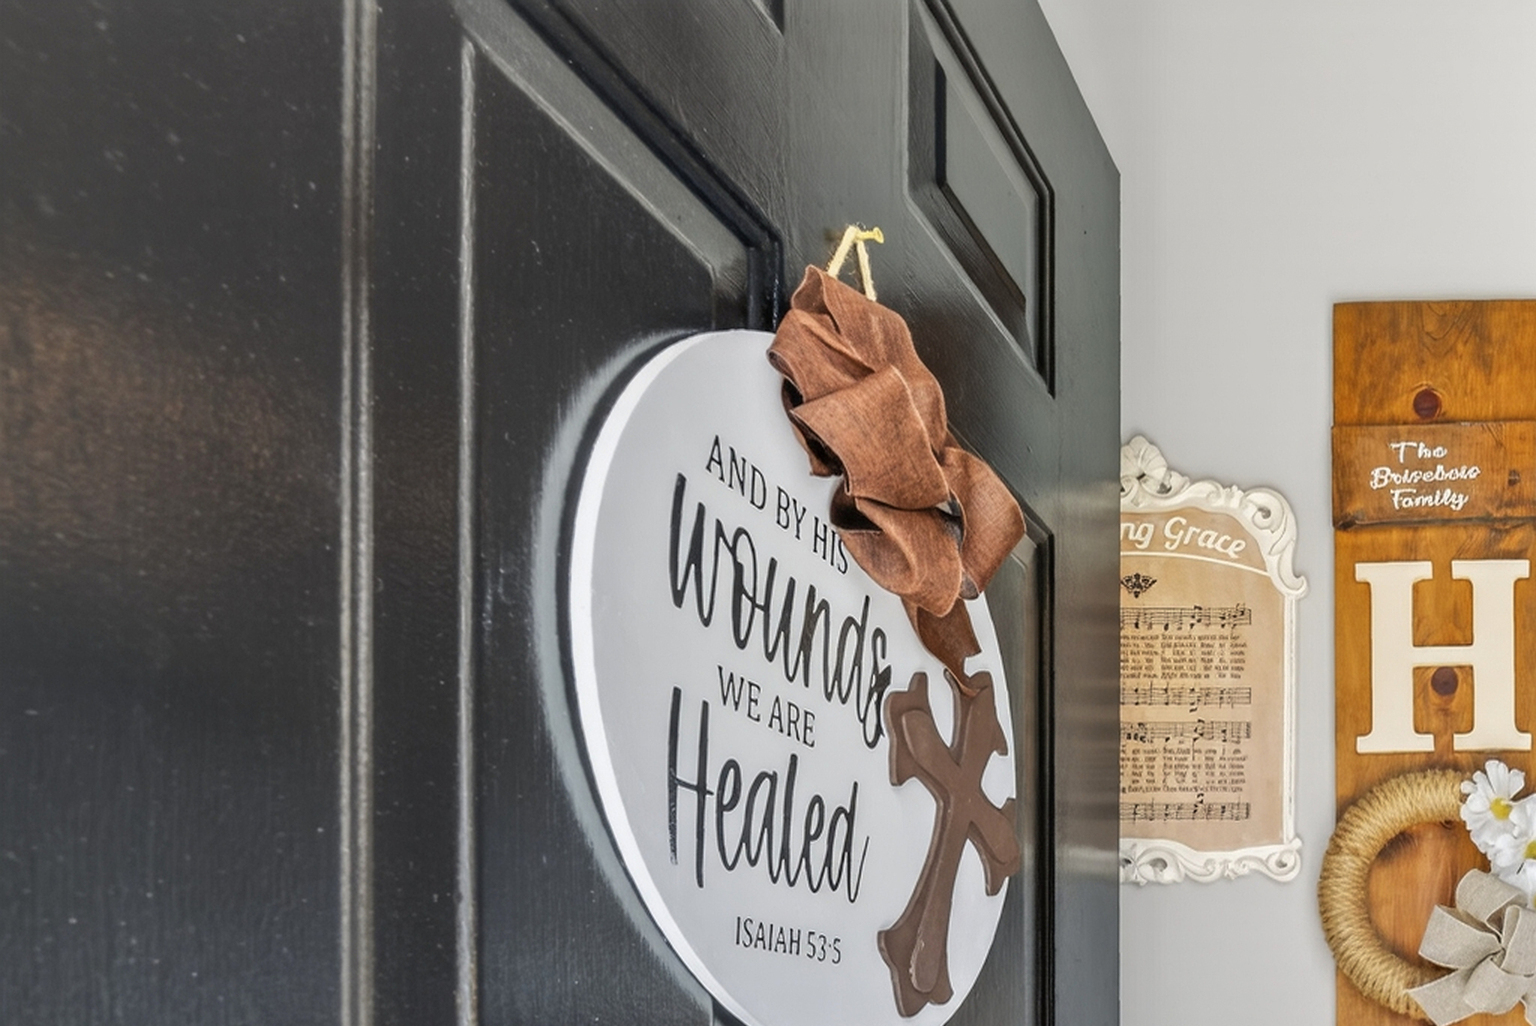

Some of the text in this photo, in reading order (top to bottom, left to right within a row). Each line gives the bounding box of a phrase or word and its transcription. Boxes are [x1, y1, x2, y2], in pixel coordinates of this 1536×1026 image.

[1389, 441, 1449, 464] The
[705, 434, 849, 575] AND BY HIS
[1389, 487, 1470, 512] Family
[1120, 515, 1247, 559] ng Grace
[668, 472, 893, 750] wounds
[717, 665, 817, 750] WE ARE
[667, 685, 870, 904] Healed
[735, 916, 802, 956] ISAIAH
